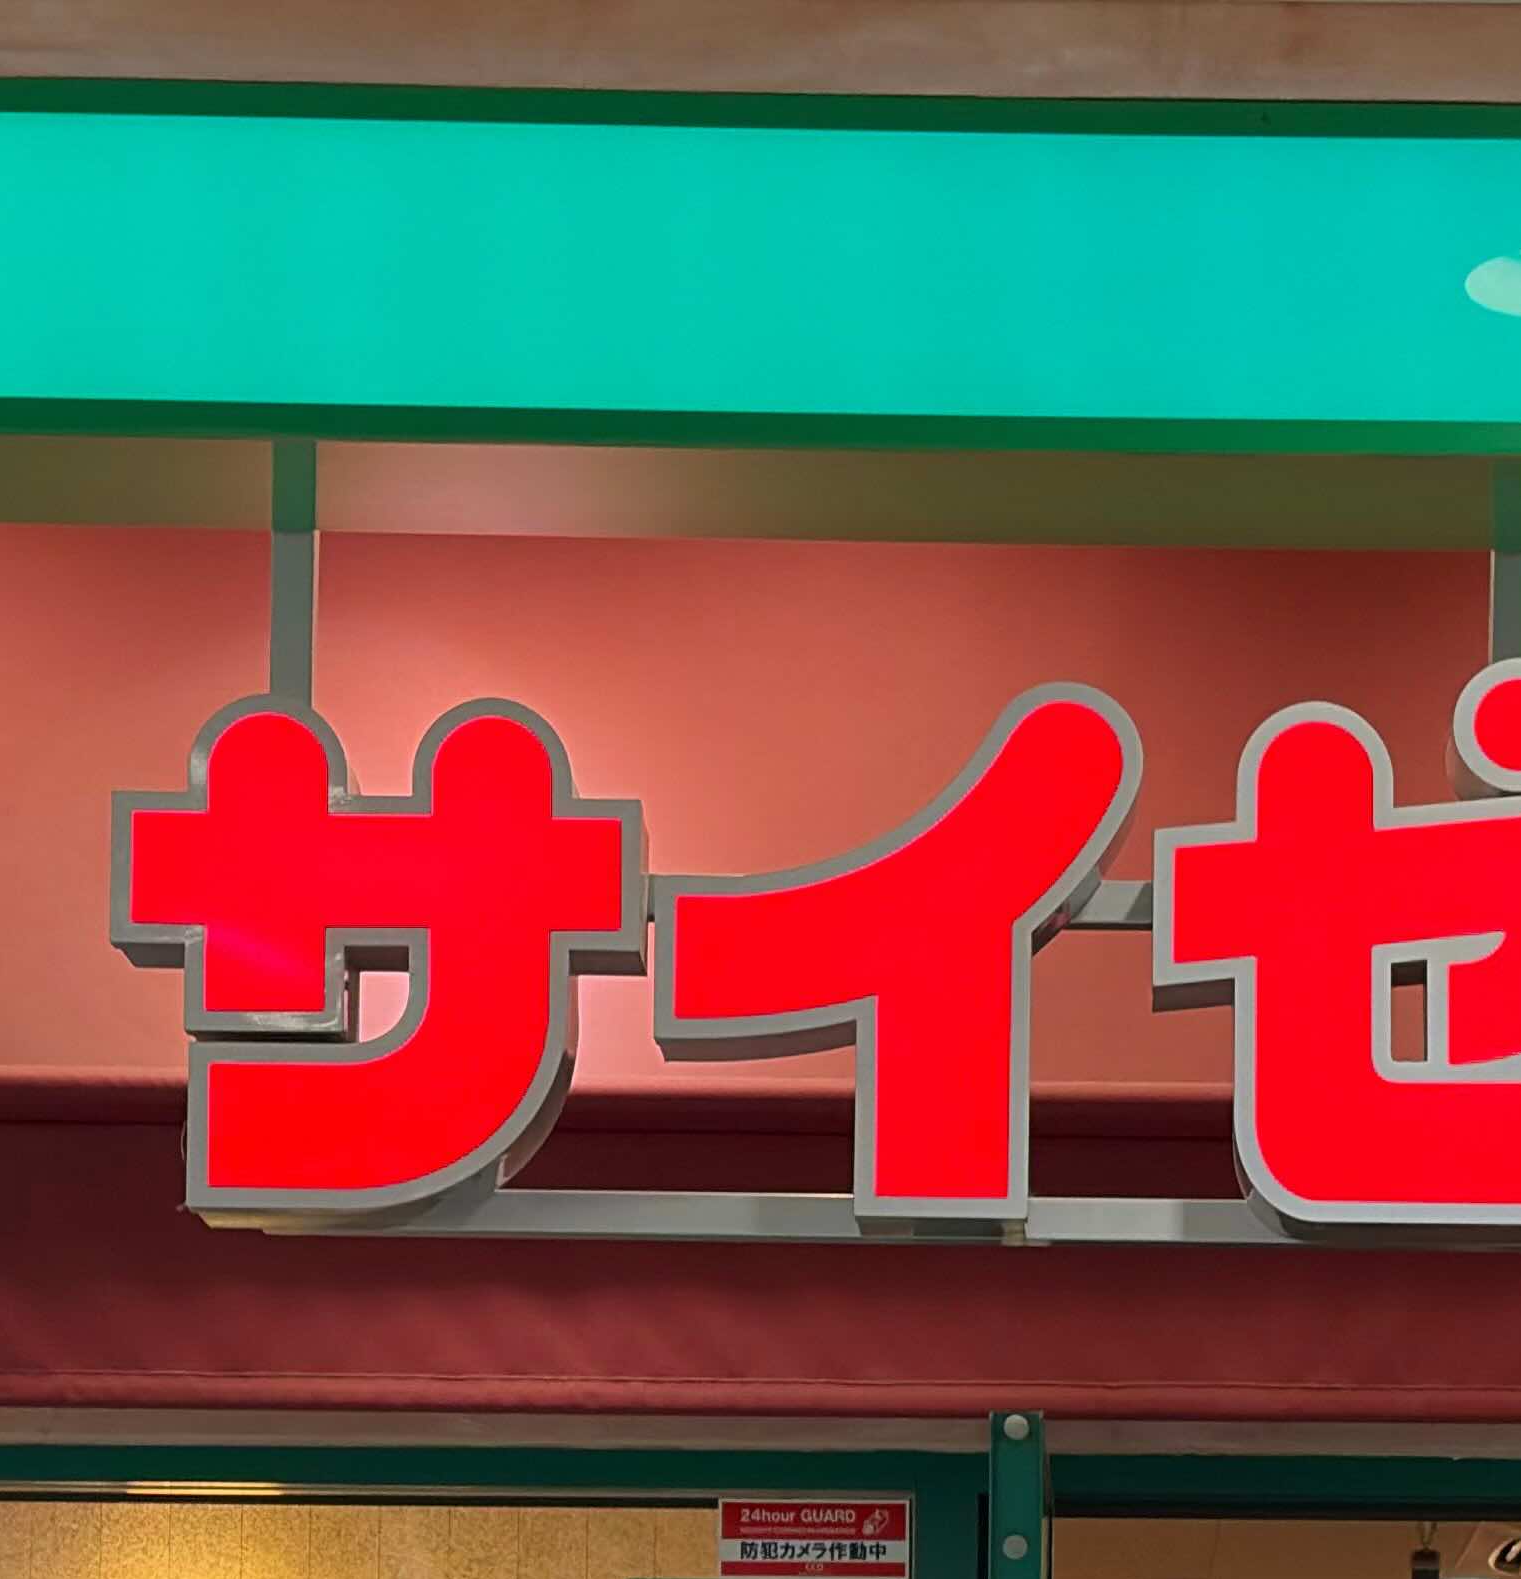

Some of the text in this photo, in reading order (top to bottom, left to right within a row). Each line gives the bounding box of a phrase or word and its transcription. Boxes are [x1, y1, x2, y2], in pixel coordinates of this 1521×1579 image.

[740, 1508, 856, 1523] 24hour GUARD
[740, 1541, 887, 1561] 防犯カメラ作動中
